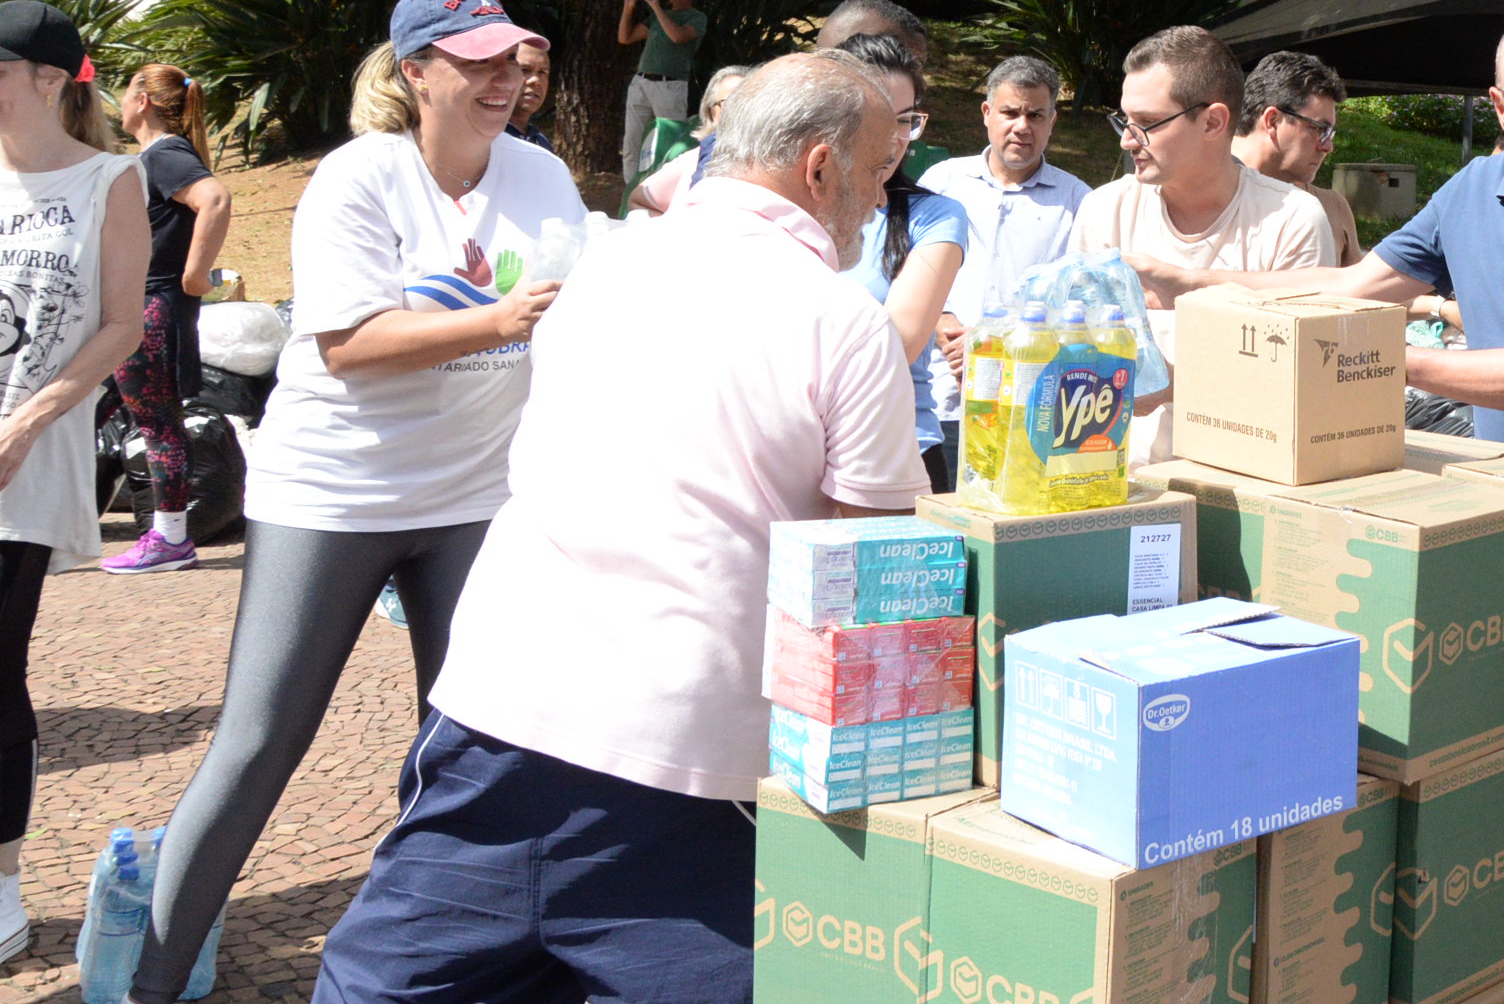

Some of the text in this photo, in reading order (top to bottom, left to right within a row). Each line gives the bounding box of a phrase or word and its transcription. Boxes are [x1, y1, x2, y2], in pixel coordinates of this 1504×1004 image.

[0, 248, 70, 273] MORRO
[1337, 349, 1381, 368] Reckitt
[1336, 364, 1396, 383] Benckiser
[1036, 374, 1055, 433] NOVA FÓRMULA
[1186, 411, 1278, 443] CONTÉM 36 UNIDADES DE 20g
[1310, 423, 1397, 444] CONTÉM 36 UNIDADES DE 20g
[1140, 534, 1172, 543] 212727
[1376, 528, 1399, 543] CBB
[879, 541, 953, 559] IceClean
[881, 567, 955, 587] IceClean
[879, 594, 953, 613] IceClean
[1132, 597, 1163, 605] ESSENCIAL
[1147, 702, 1186, 719] Dr.Oetker
[907, 719, 939, 731] IceClean
[942, 714, 973, 726] IceClean
[832, 731, 865, 742] IceClean
[870, 724, 903, 737] IceClean
[905, 747, 936, 759] IceClean
[941, 742, 971, 754] IceClean
[829, 759, 862, 770] IceClean
[905, 774, 936, 786] IceClean
[940, 769, 971, 781] IceClean
[830, 787, 863, 799] IceClean
[868, 780, 901, 792] IceClean
[1144, 795, 1344, 864] Contém 18 unidades
[1222, 842, 1243, 861] CBB
[816, 914, 886, 962] CBB
